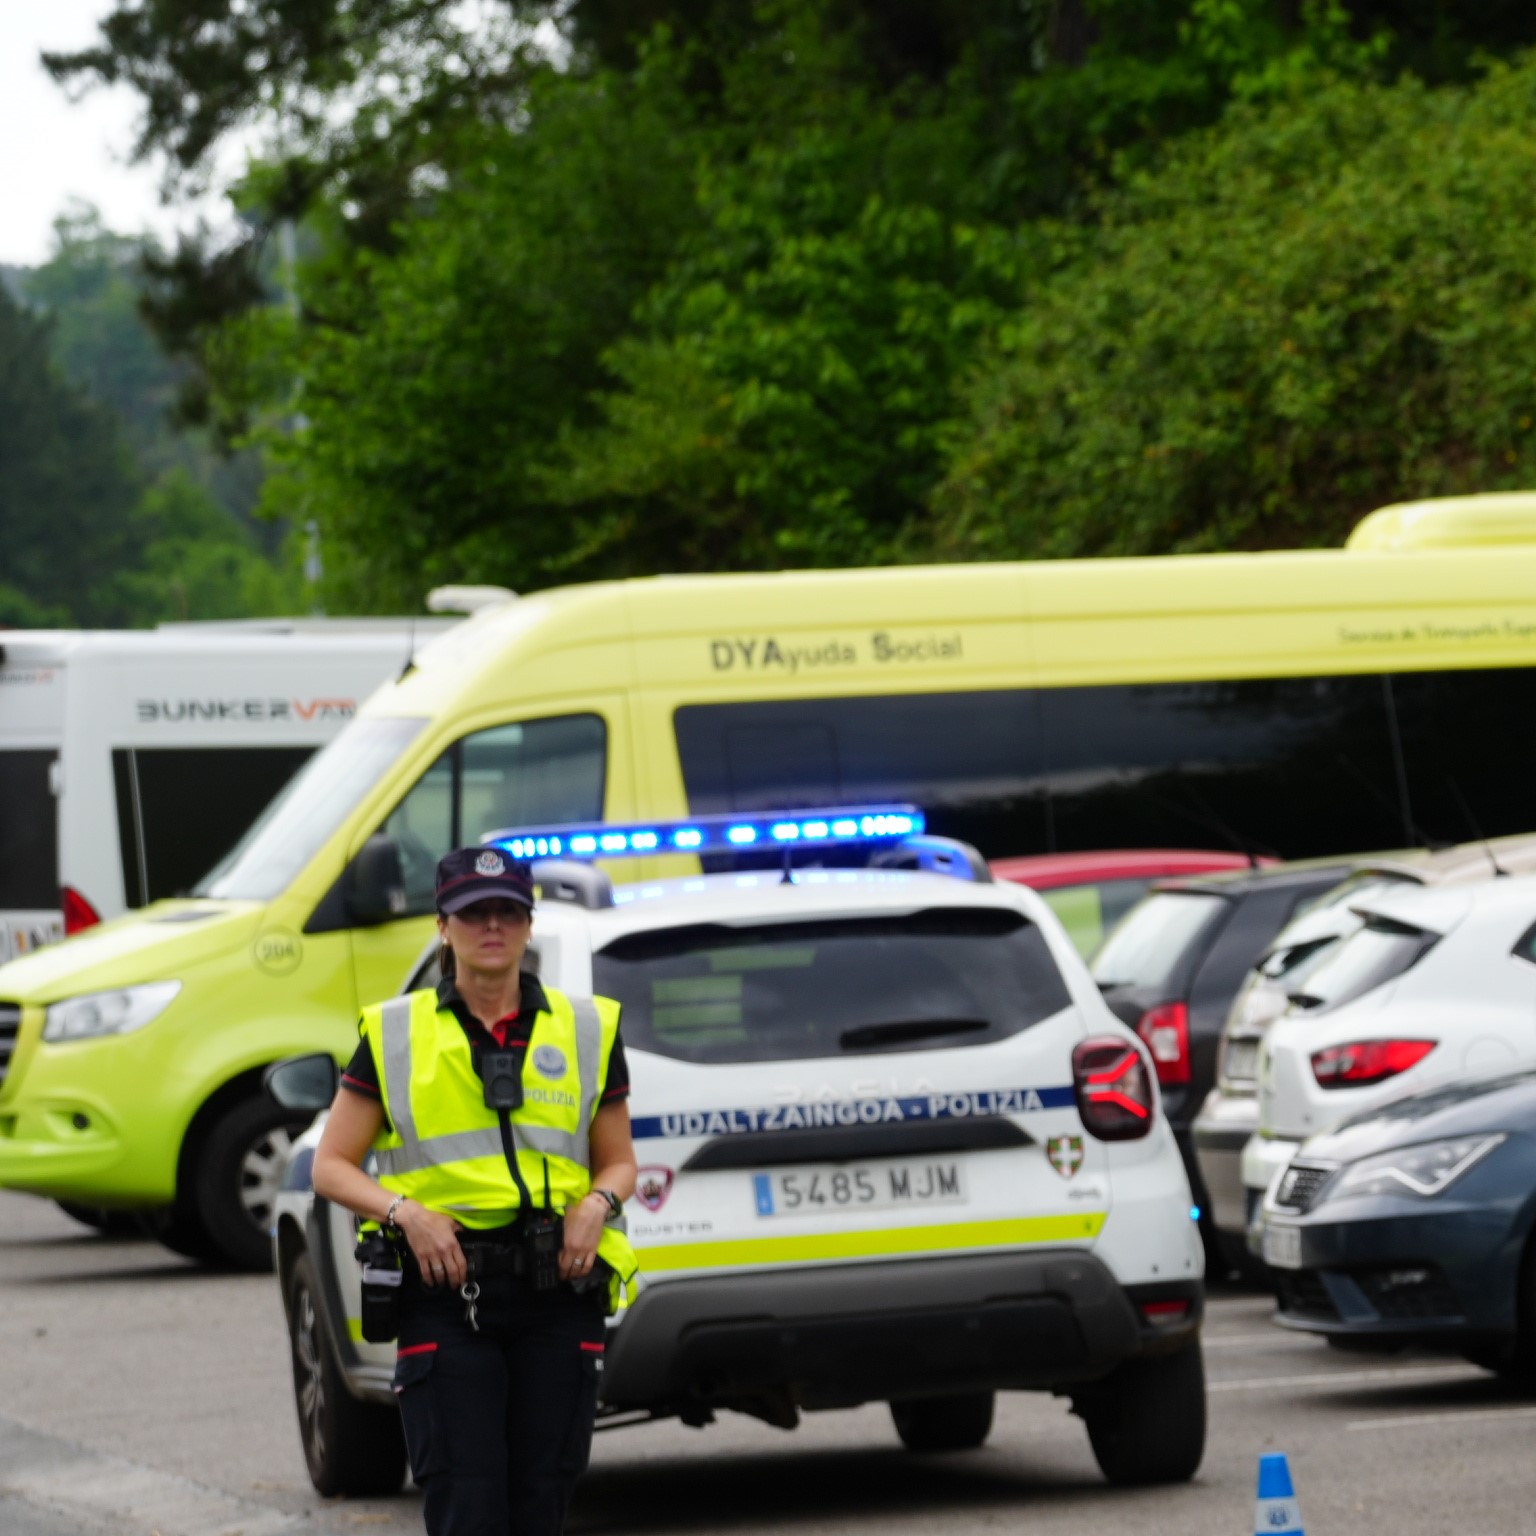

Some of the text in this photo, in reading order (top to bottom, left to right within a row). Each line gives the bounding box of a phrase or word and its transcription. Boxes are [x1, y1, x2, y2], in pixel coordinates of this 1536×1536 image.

[871, 629, 964, 663] Social
[659, 1099, 904, 1137] UDALTZAINGOA
[928, 1090, 1045, 1119] POLIZIA
[781, 1163, 960, 1209] 5485 MJM
